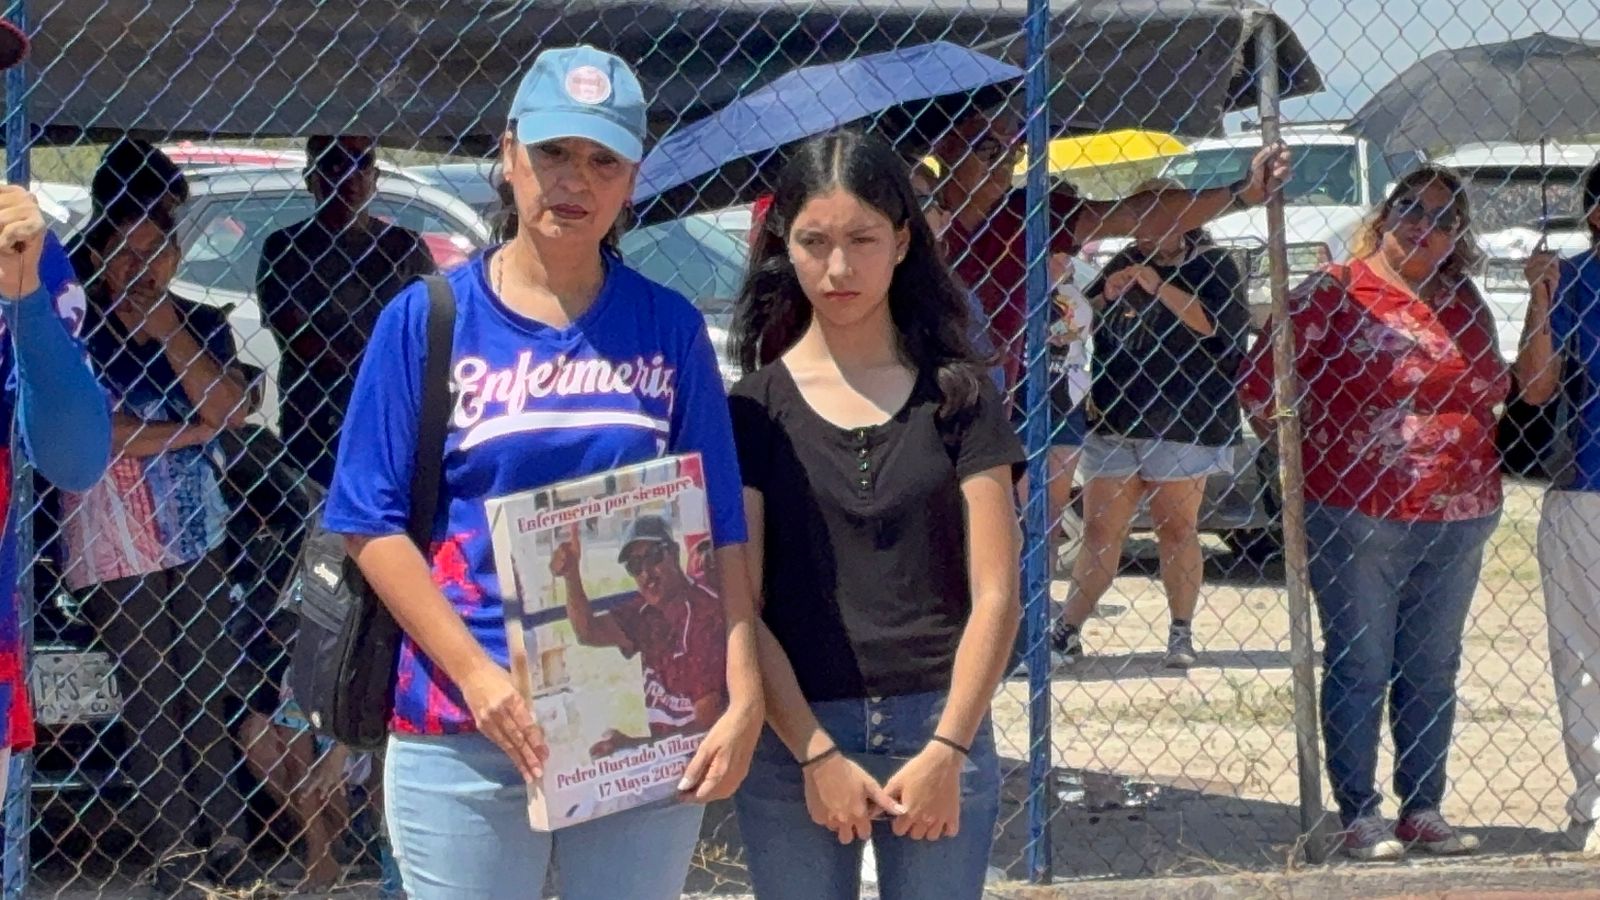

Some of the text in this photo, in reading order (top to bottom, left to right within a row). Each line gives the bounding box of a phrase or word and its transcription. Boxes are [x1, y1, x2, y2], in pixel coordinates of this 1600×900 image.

[605, 493, 630, 515] por
[557, 767, 597, 788] Pedro
[599, 748, 657, 774] Hurtado
[599, 781, 612, 798] 17
[615, 775, 650, 793] Mayo
